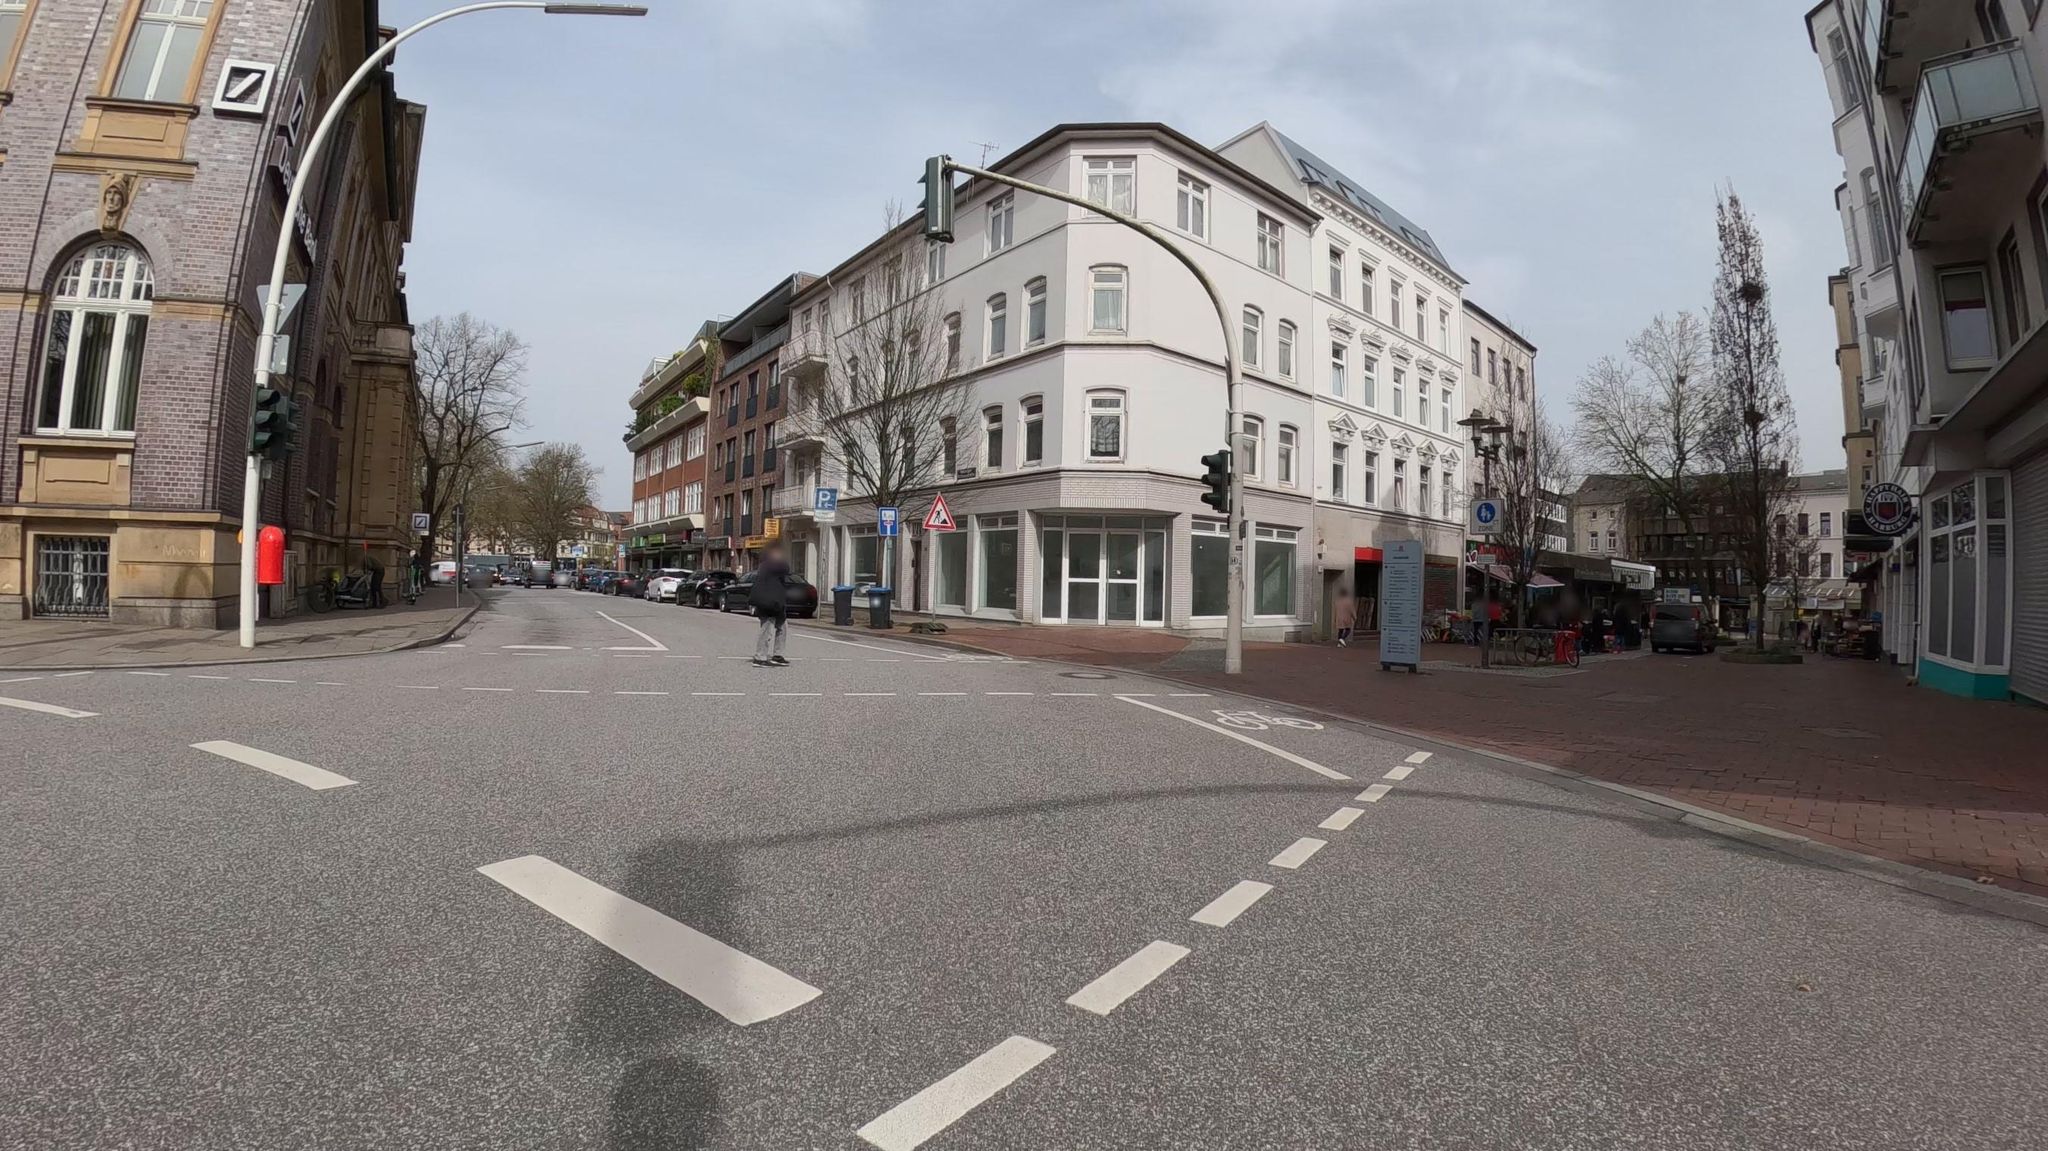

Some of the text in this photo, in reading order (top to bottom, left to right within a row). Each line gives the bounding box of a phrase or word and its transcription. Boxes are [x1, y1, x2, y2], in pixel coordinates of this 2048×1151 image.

[818, 491, 831, 508] P
[1866, 485, 1909, 503] HAPPY HAIR
[1868, 516, 1908, 531] HARBURG
